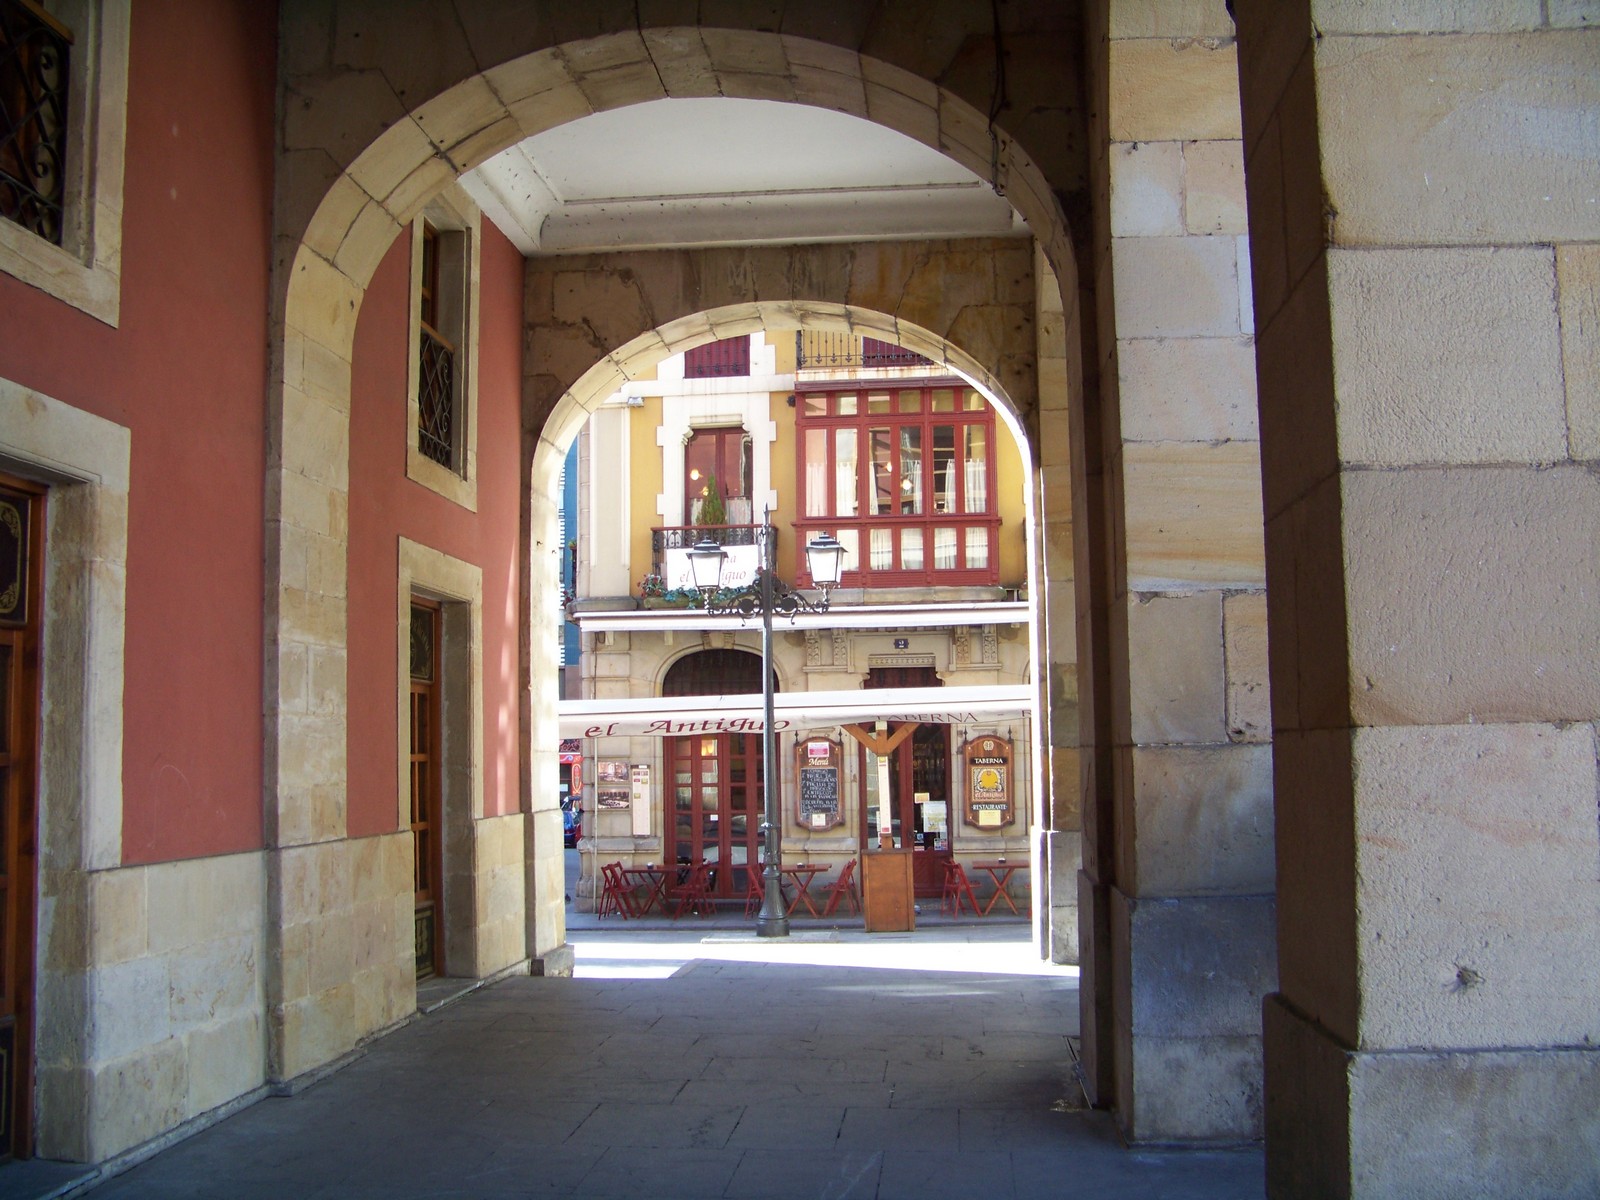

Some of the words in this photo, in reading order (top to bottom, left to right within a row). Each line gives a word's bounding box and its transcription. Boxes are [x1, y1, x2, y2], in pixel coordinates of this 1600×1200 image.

[679, 569, 690, 583] el
[898, 640, 905, 648] 2
[584, 722, 619, 738] el
[974, 757, 1004, 765] TABERNA
[972, 803, 1006, 811] RESTAURANTE
